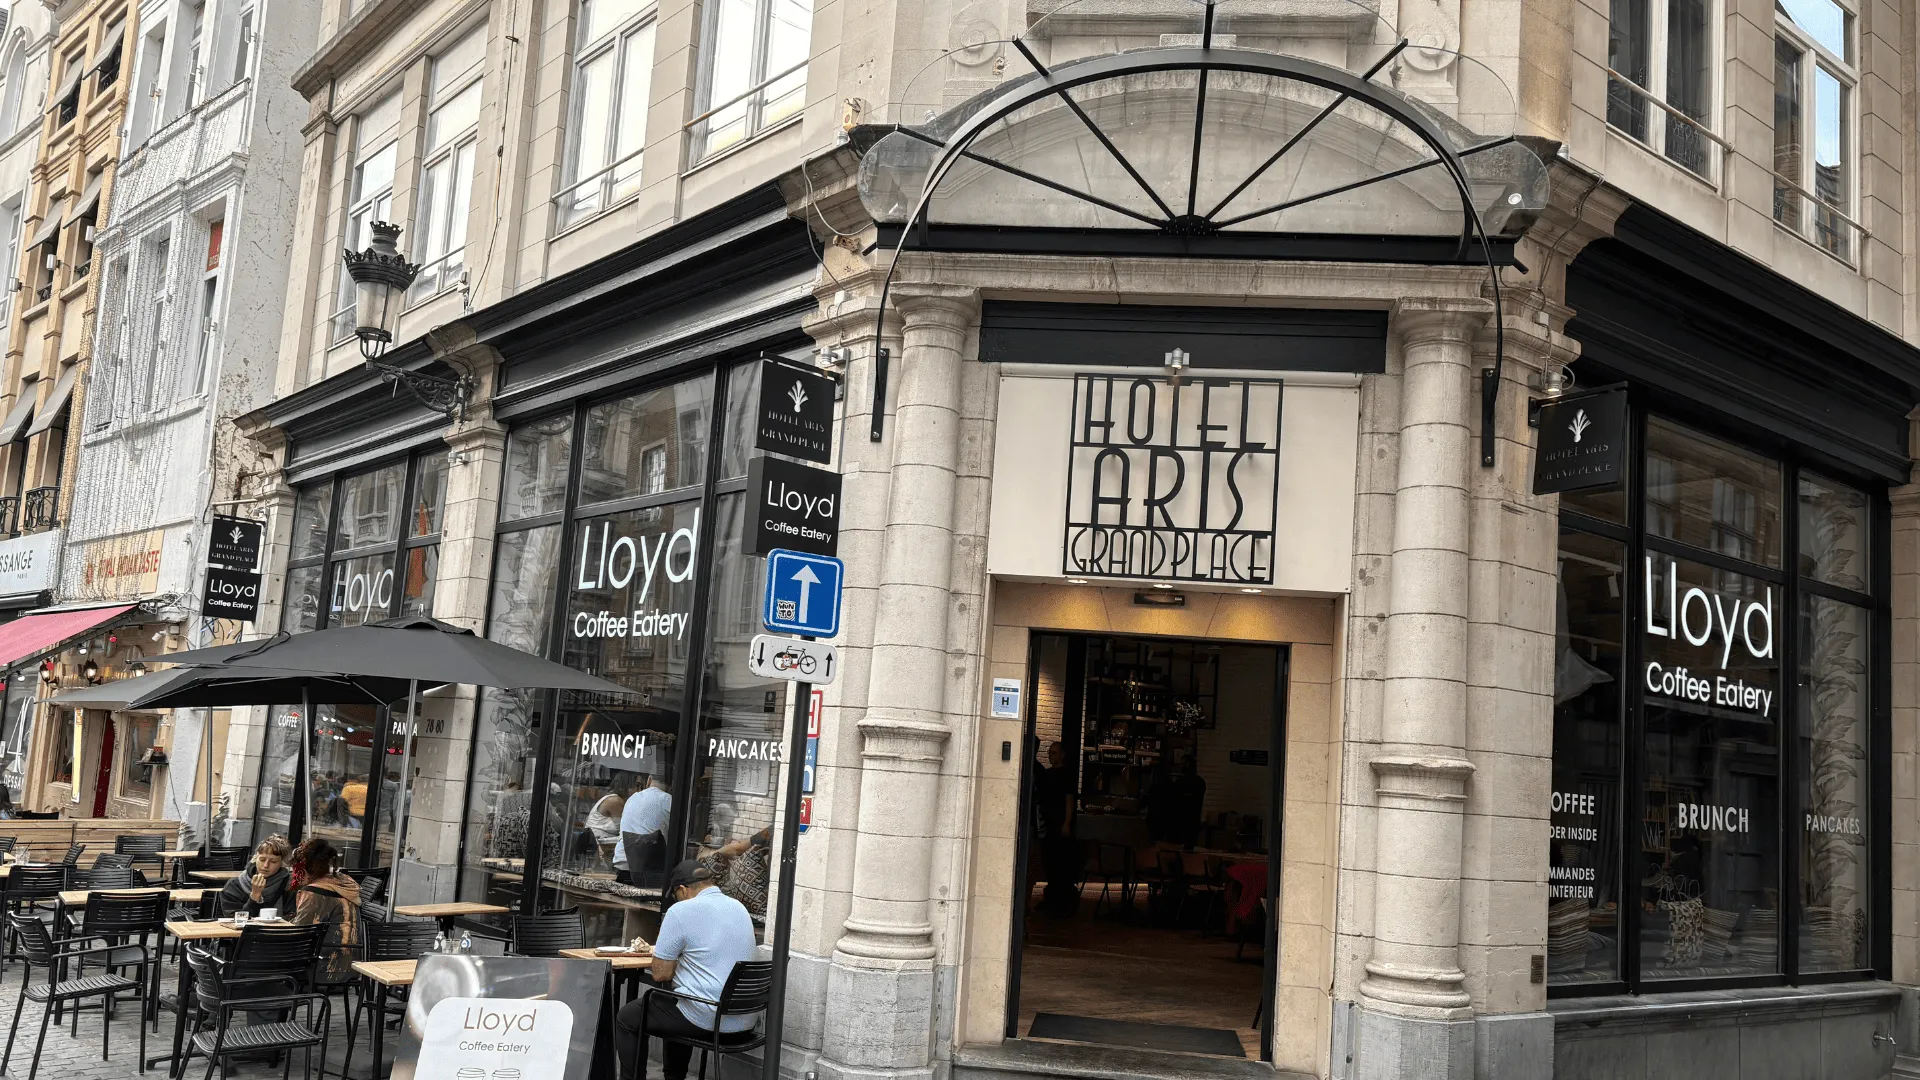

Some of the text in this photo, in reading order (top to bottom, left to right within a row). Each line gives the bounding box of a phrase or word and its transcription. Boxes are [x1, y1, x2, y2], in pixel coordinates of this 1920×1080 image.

[768, 410, 800, 427] HOTEL
[1084, 376, 1267, 450] HOTEL
[762, 428, 827, 451] GRAND PLACE
[1541, 468, 1576, 481] RAND
[767, 480, 835, 519] Lloyd
[765, 519, 832, 543] Coffee Eatery
[216, 542, 238, 553] HOTEL
[578, 507, 700, 605] Lloyd
[1071, 527, 1269, 583] GRAND PLACE
[138, 550, 160, 574] TASTE
[210, 579, 257, 599] Lloyd
[208, 598, 254, 611] Coffee Eatery
[1645, 557, 1774, 669] Lloyd
[574, 608, 689, 640] Coffee Eatery
[1646, 661, 1773, 717] Coffee Eatery
[1001, 697, 1010, 706] H
[278, 714, 298, 728] COFFEE
[392, 721, 418, 736] PANA
[425, 719, 445, 734] 78 80
[581, 732, 646, 759] BRUNCH
[708, 738, 784, 762] PANCAKES
[1551, 791, 1595, 815] OFFEE
[1678, 802, 1749, 833] BRUNCH
[1806, 813, 1860, 836] PANCAKES
[1550, 825, 1598, 841] DER INSIDE
[1549, 866, 1595, 881] MMANDES
[1549, 884, 1594, 899] INTERIEUR
[463, 1007, 537, 1035] Lloyd
[459, 1040, 531, 1055] Coffee Eatery
